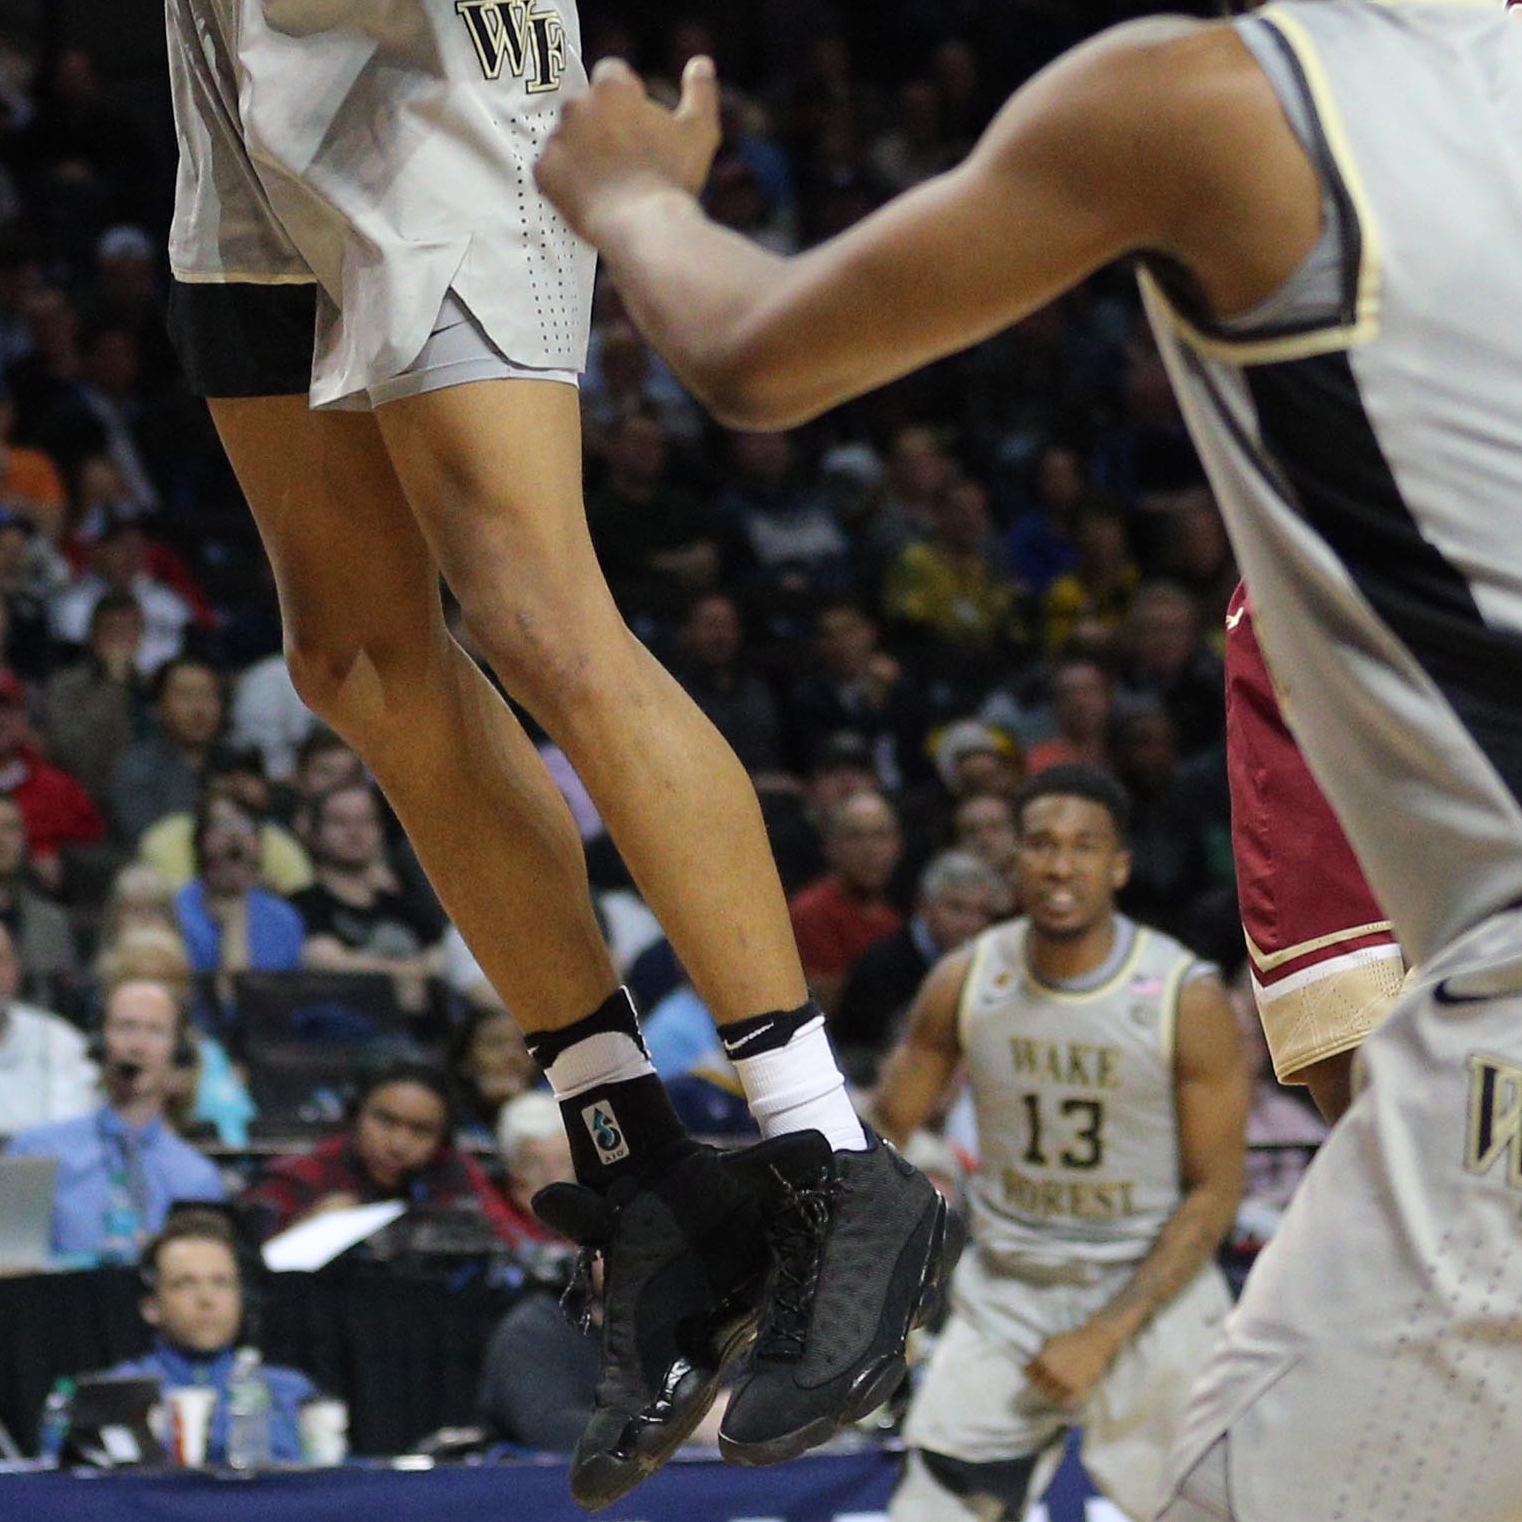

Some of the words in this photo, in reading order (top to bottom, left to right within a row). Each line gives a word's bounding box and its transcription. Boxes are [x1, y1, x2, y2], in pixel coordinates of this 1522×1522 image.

[1009, 1036, 1121, 1089] WAKE
[1022, 1092, 1104, 1170] 13
[1001, 1165, 1139, 1221] FOREST
